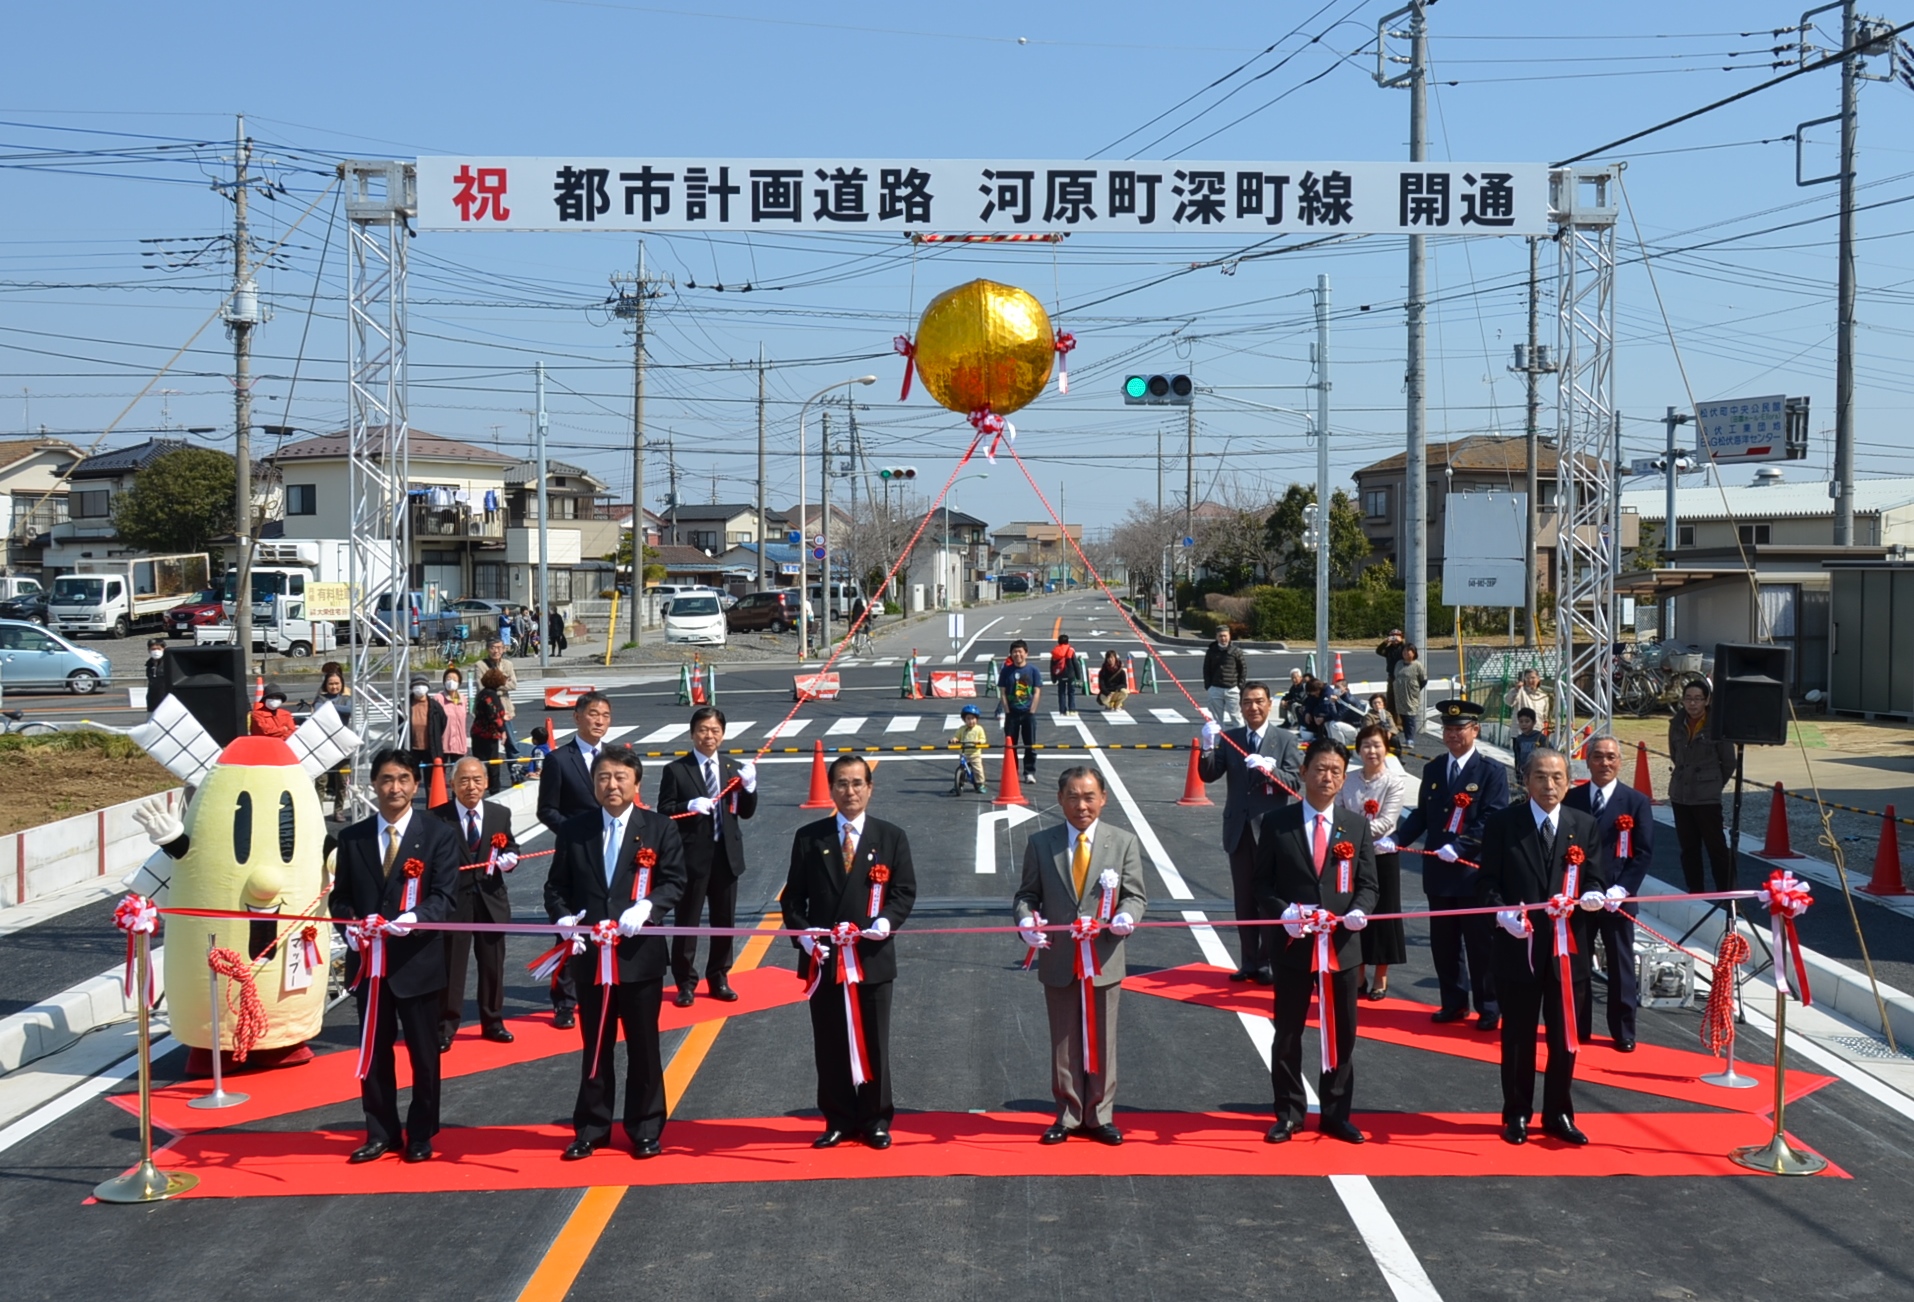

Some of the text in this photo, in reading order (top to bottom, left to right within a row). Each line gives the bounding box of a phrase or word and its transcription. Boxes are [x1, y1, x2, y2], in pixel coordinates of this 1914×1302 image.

[453, 166, 1515, 227] 祝 都市計画道路 河原町深町線 開通
[1700, 402, 1781, 418] 松伏町中央公民館
[1700, 432, 1781, 447] BG松伏海洋センター
